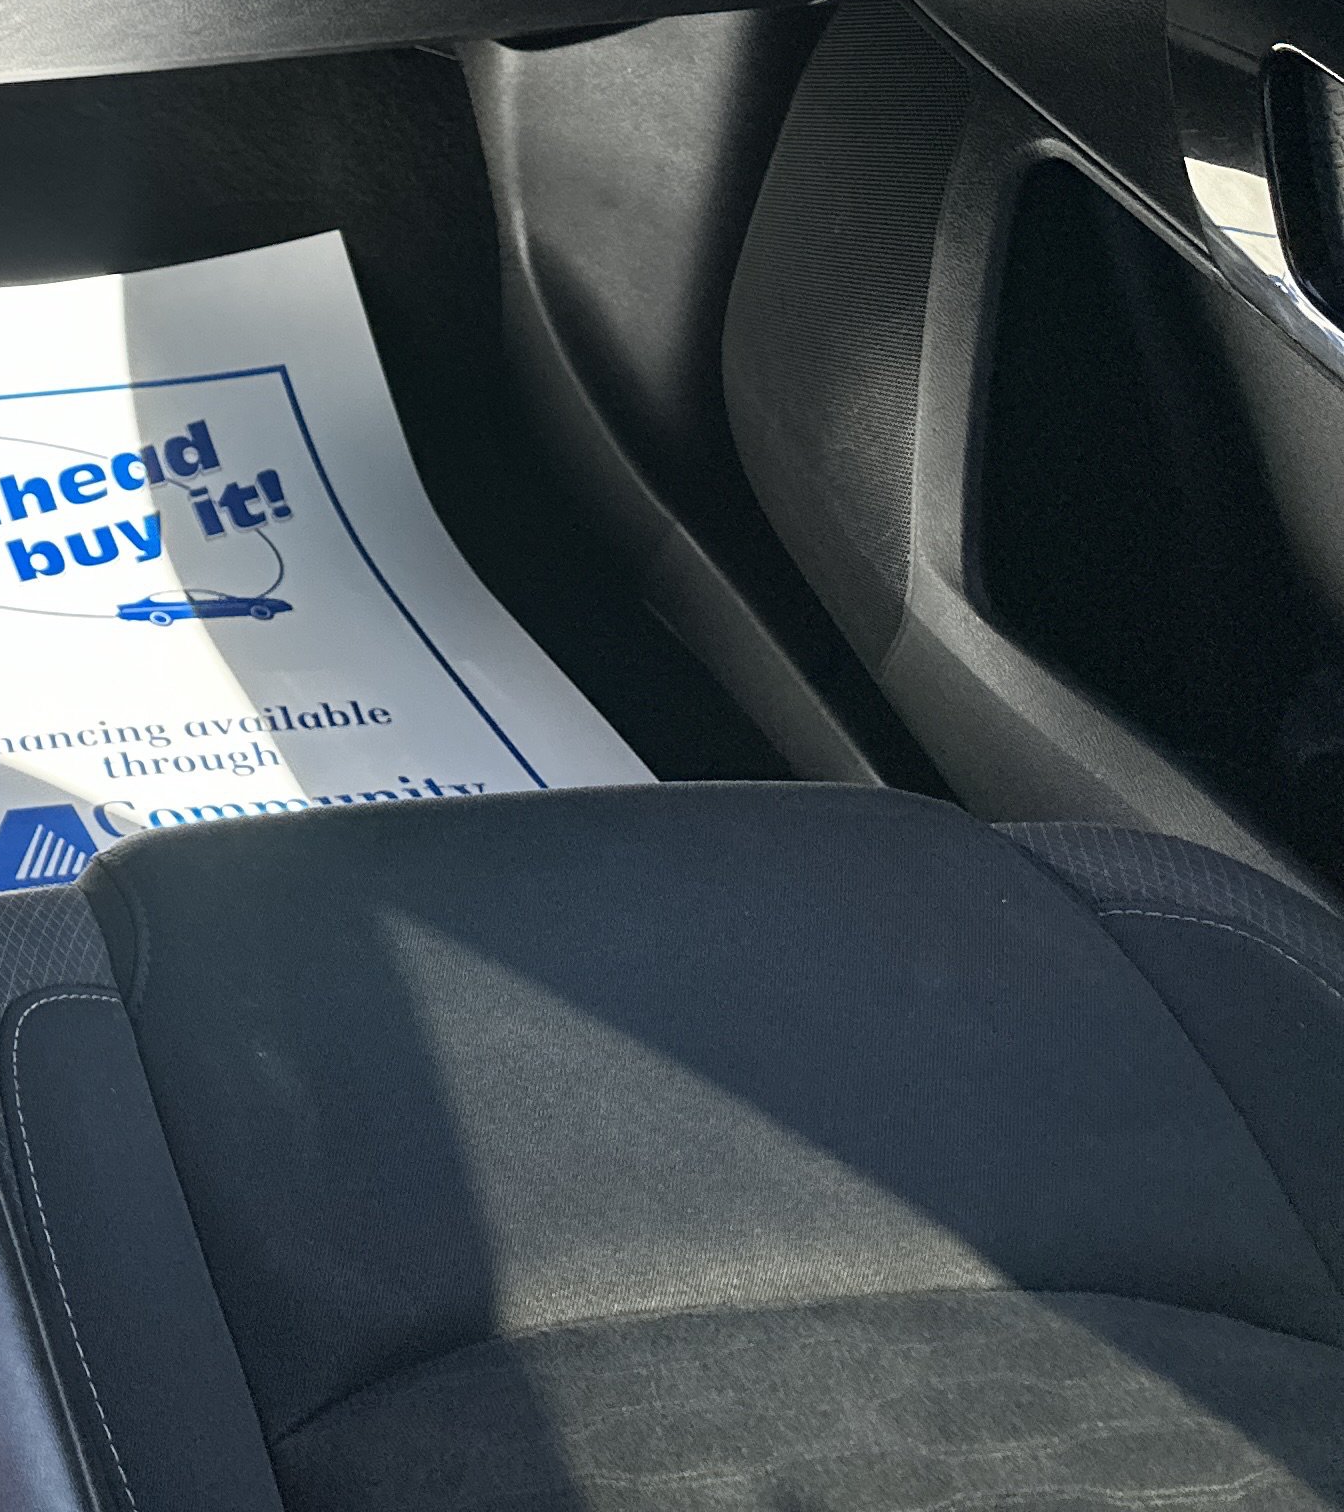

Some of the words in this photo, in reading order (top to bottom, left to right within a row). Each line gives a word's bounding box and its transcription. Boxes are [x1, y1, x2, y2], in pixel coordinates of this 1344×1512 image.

[5, 509, 163, 584] buy
[188, 468, 293, 543] it!
[184, 699, 394, 739] available
[102, 741, 284, 780] through
